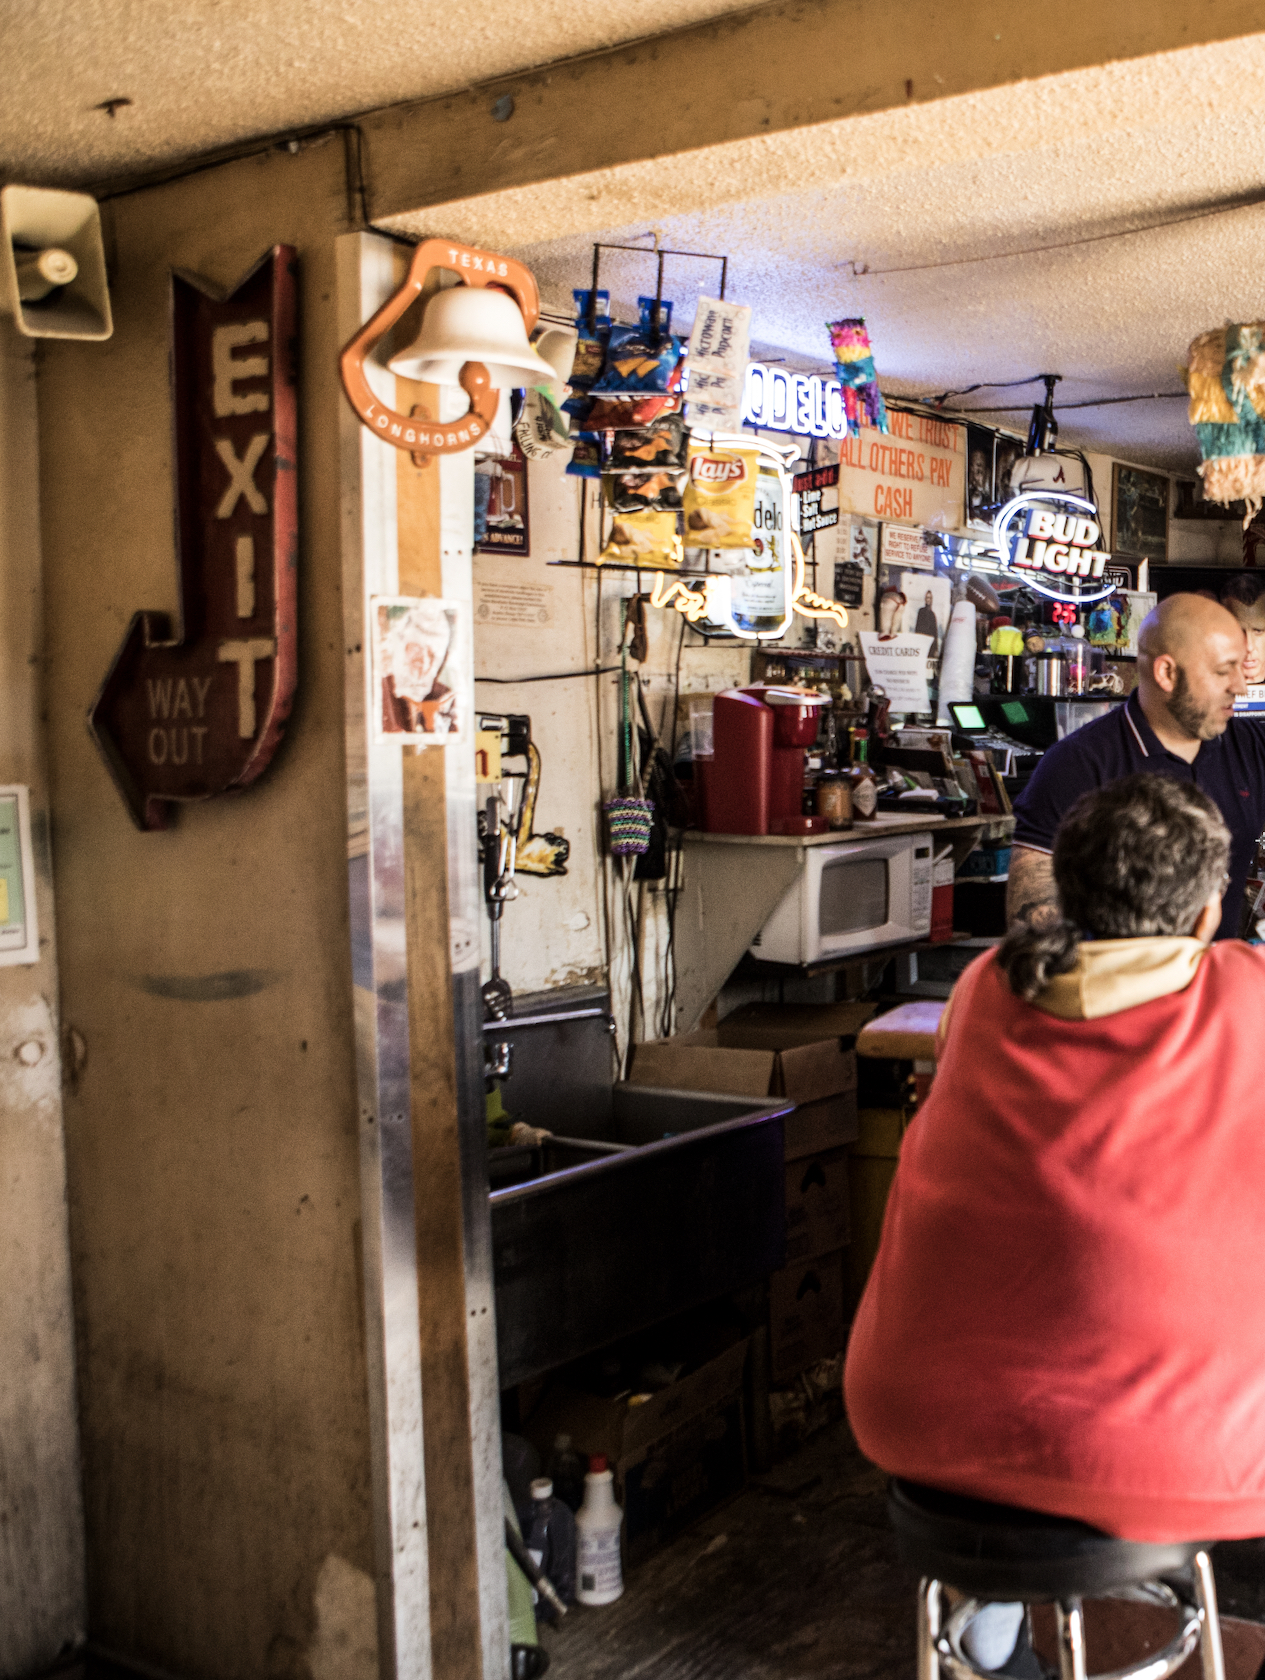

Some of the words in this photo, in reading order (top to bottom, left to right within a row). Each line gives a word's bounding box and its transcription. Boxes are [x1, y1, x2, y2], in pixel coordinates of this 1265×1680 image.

[449, 250, 508, 277] TEXAS
[741, 362, 848, 440] ODELO
[364, 404, 481, 446] LONGHORNS
[891, 410, 913, 441] WE
[918, 416, 959, 453] TRUST
[693, 456, 742, 483] Lay's
[839, 437, 866, 470] ALL
[869, 442, 925, 484] OTHERS
[930, 457, 952, 488] PAY
[754, 501, 782, 531] delo
[874, 484, 913, 518] CASH
[213, 323, 275, 738] EXIT
[1027, 509, 1100, 547] BUD
[1013, 538, 1111, 579] LIGHT
[868, 646, 893, 656] CREDIT
[895, 647, 920, 657] CARDS
[147, 677, 211, 722] WAY
[148, 726, 208, 766] OUT
